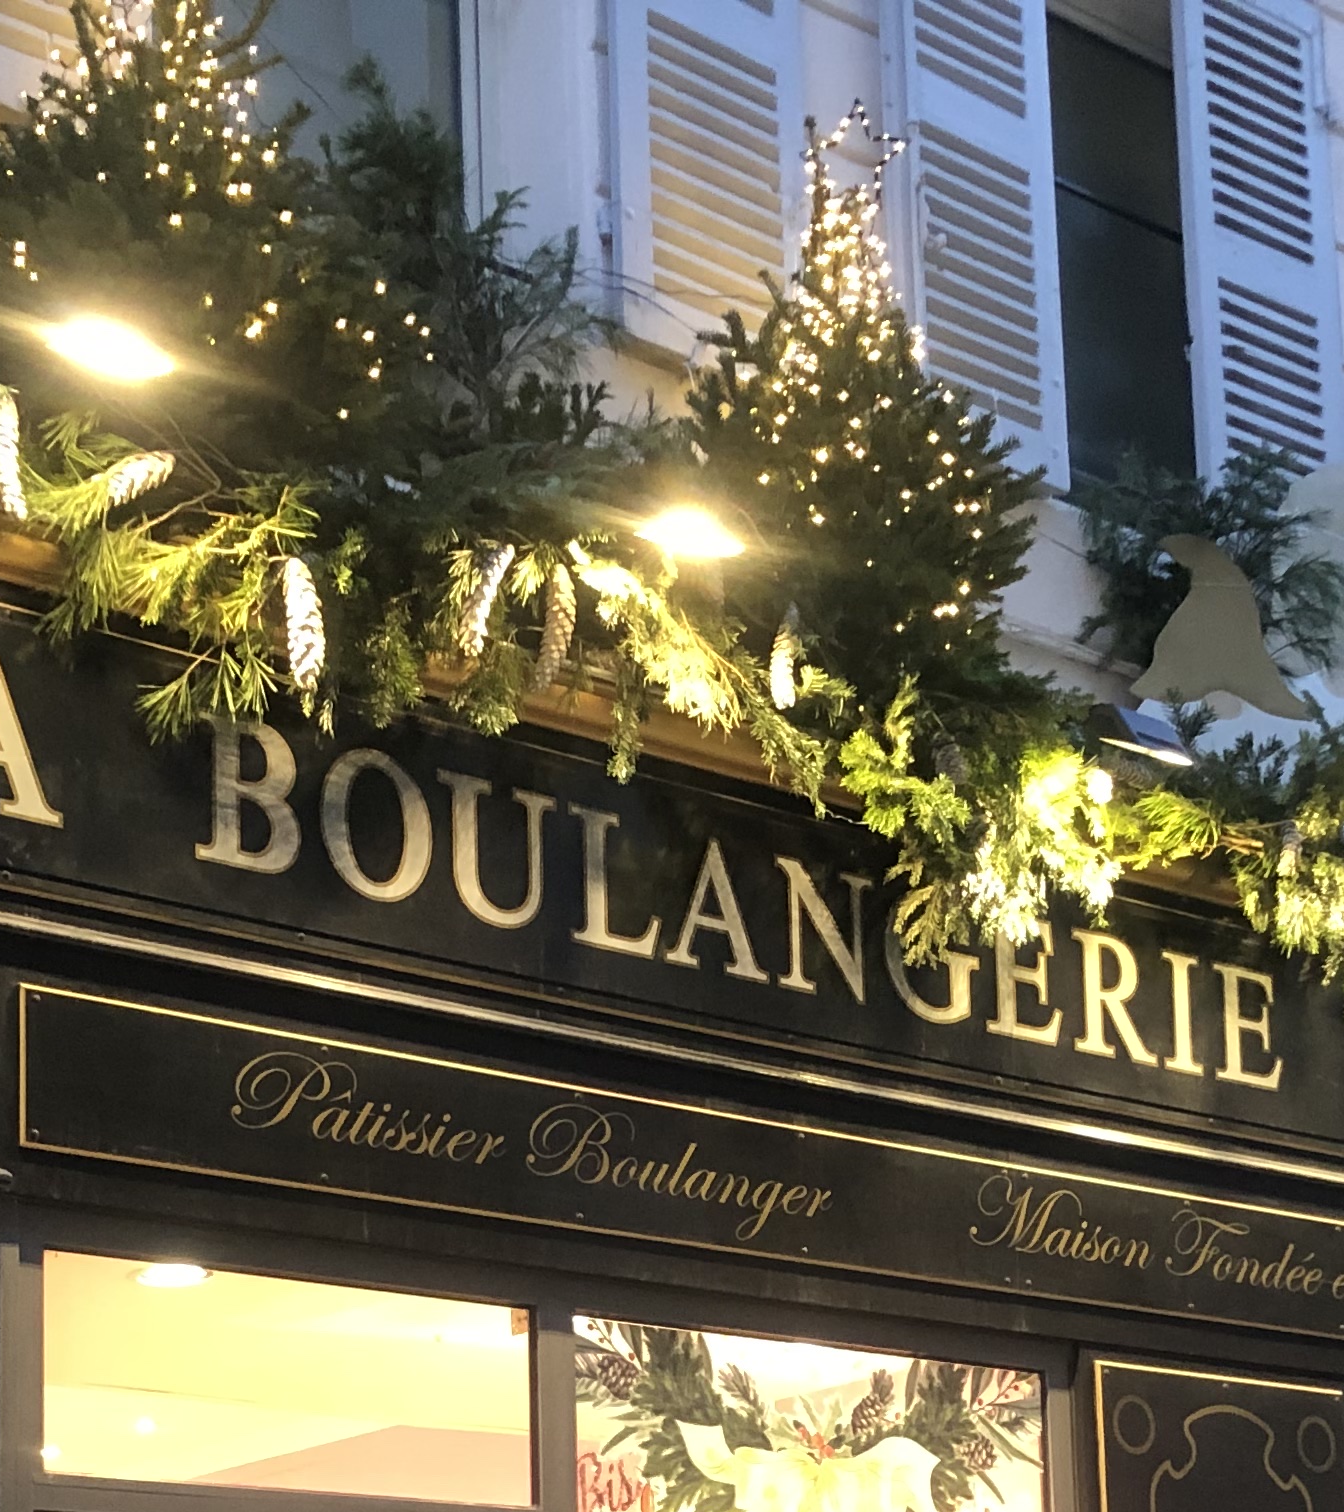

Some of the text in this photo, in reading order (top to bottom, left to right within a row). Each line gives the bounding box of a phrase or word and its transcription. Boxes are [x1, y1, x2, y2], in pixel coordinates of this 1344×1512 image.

[194, 712, 1284, 1092] BOULANGERIE
[230, 1050, 834, 1241] Pâtissier Boulanger
[969, 1174, 1155, 1271] Maison
[1164, 1208, 1324, 1292] Fondée
